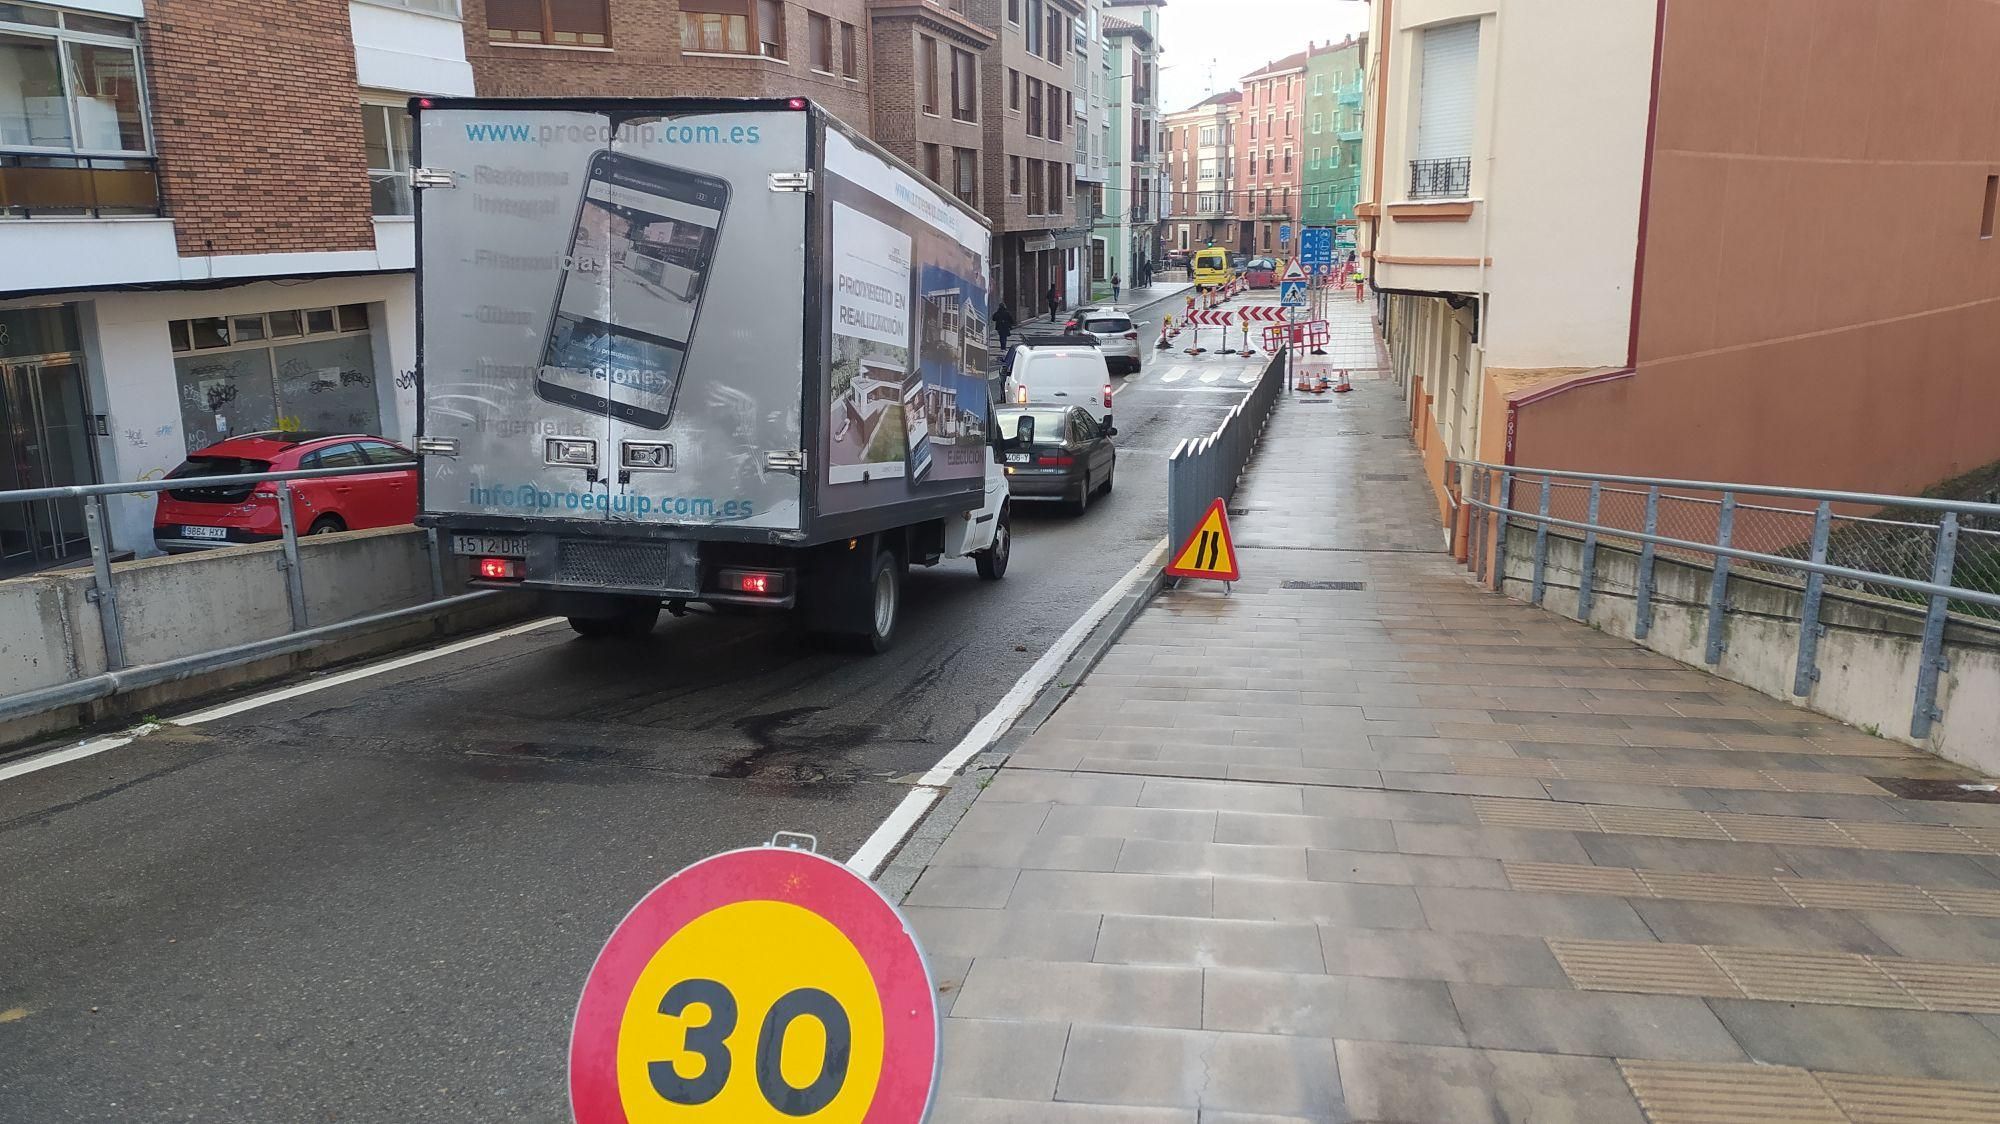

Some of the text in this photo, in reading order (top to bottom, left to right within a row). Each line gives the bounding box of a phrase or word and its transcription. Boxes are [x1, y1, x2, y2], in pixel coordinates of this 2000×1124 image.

[466, 123, 760, 147] www.proequip.com.es
[895, 292, 906, 311] EN
[469, 483, 754, 518] info@proequip.com.es
[459, 537, 496, 553] 1512
[647, 978, 852, 1118] 30
